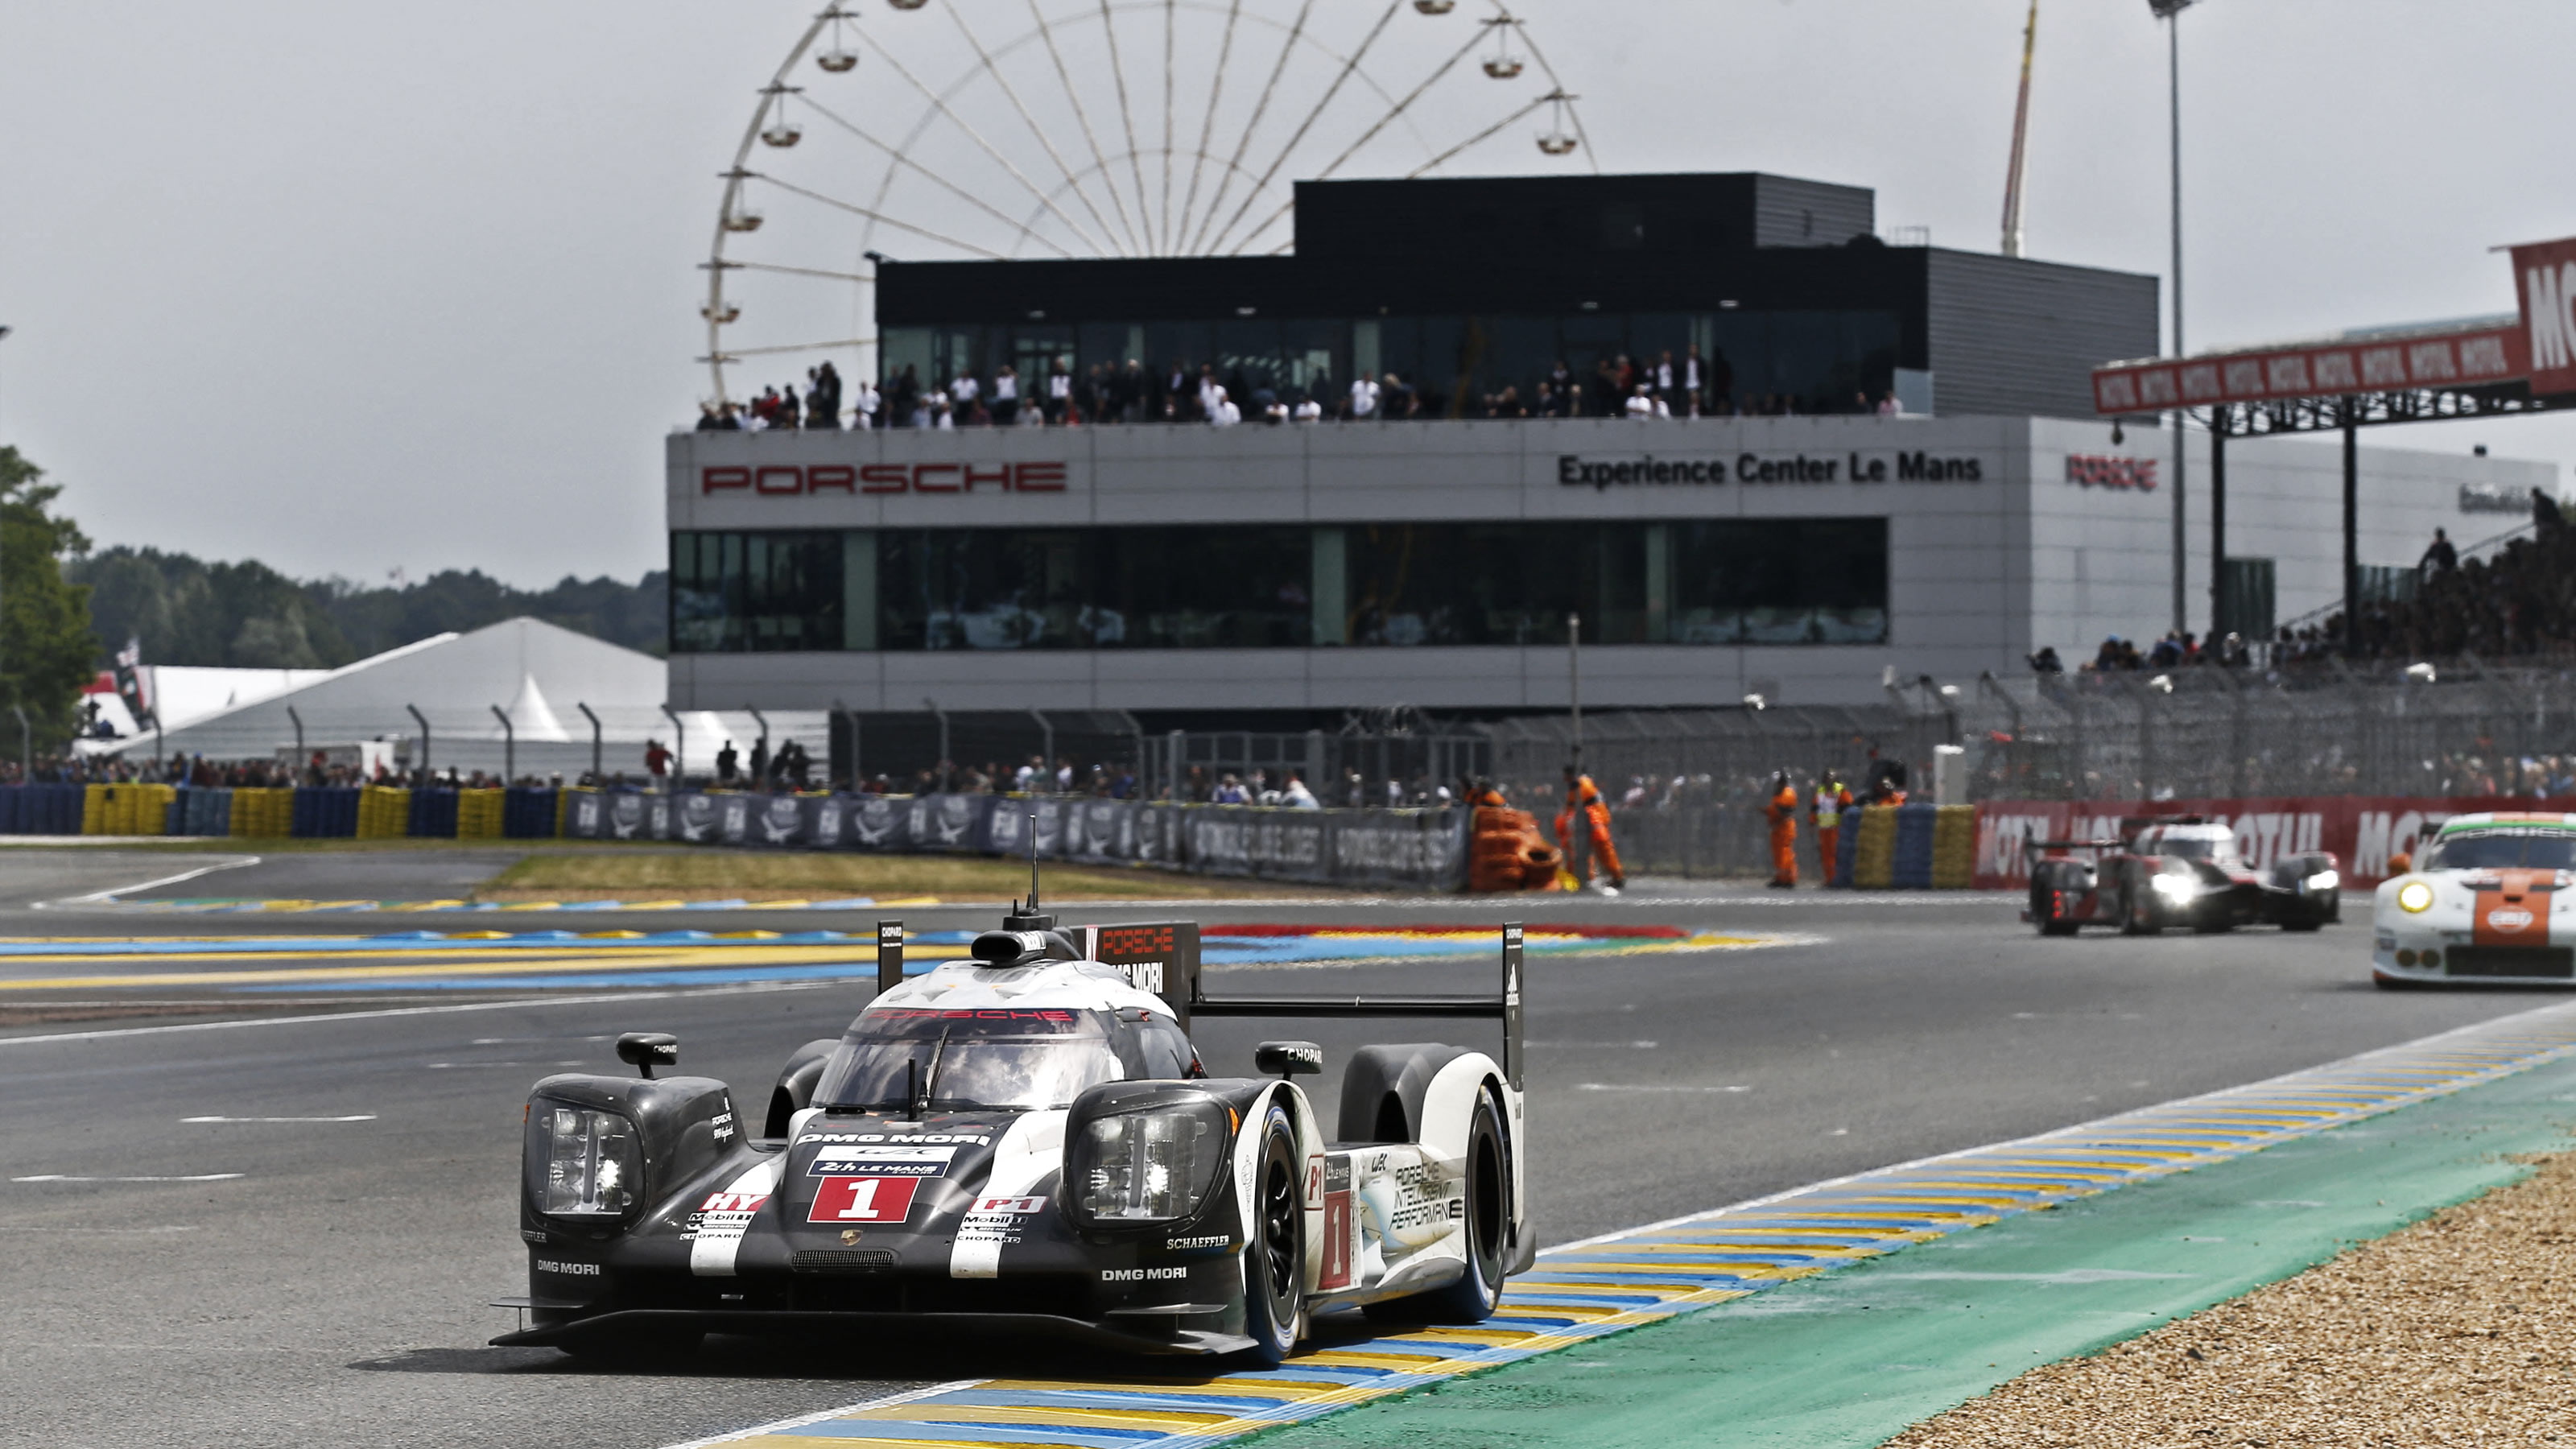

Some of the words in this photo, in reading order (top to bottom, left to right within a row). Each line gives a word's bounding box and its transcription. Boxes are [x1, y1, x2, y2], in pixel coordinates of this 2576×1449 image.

[702, 462, 1067, 496] PORSCHE
[1558, 454, 1726, 490] Experience
[1736, 452, 1838, 483] Center
[1850, 452, 1887, 482] Le
[1897, 450, 1982, 481] Mans
[1103, 927, 1173, 956] PORSCHE
[1132, 962, 1163, 993] MORI
[866, 1009, 1073, 1022] PORSCHE
[653, 1044, 677, 1054] CHOPARD
[1287, 1047, 1323, 1064] CHOPAR
[795, 1133, 885, 1146] DMG
[889, 1133, 991, 1147] MORI
[1308, 1166, 1323, 1201] P1
[1395, 1161, 1439, 1187] PORSCHE
[701, 1192, 767, 1211] HY
[837, 1179, 881, 1219] 1
[984, 1199, 1034, 1210] P1
[1166, 1235, 1229, 1249] SCHAEFFLER
[1332, 1204, 1341, 1275] 1
[538, 1259, 559, 1272] DMG
[560, 1262, 600, 1275] MORI
[1101, 1269, 1145, 1281] DMG
[1146, 1266, 1187, 1279] MORI
